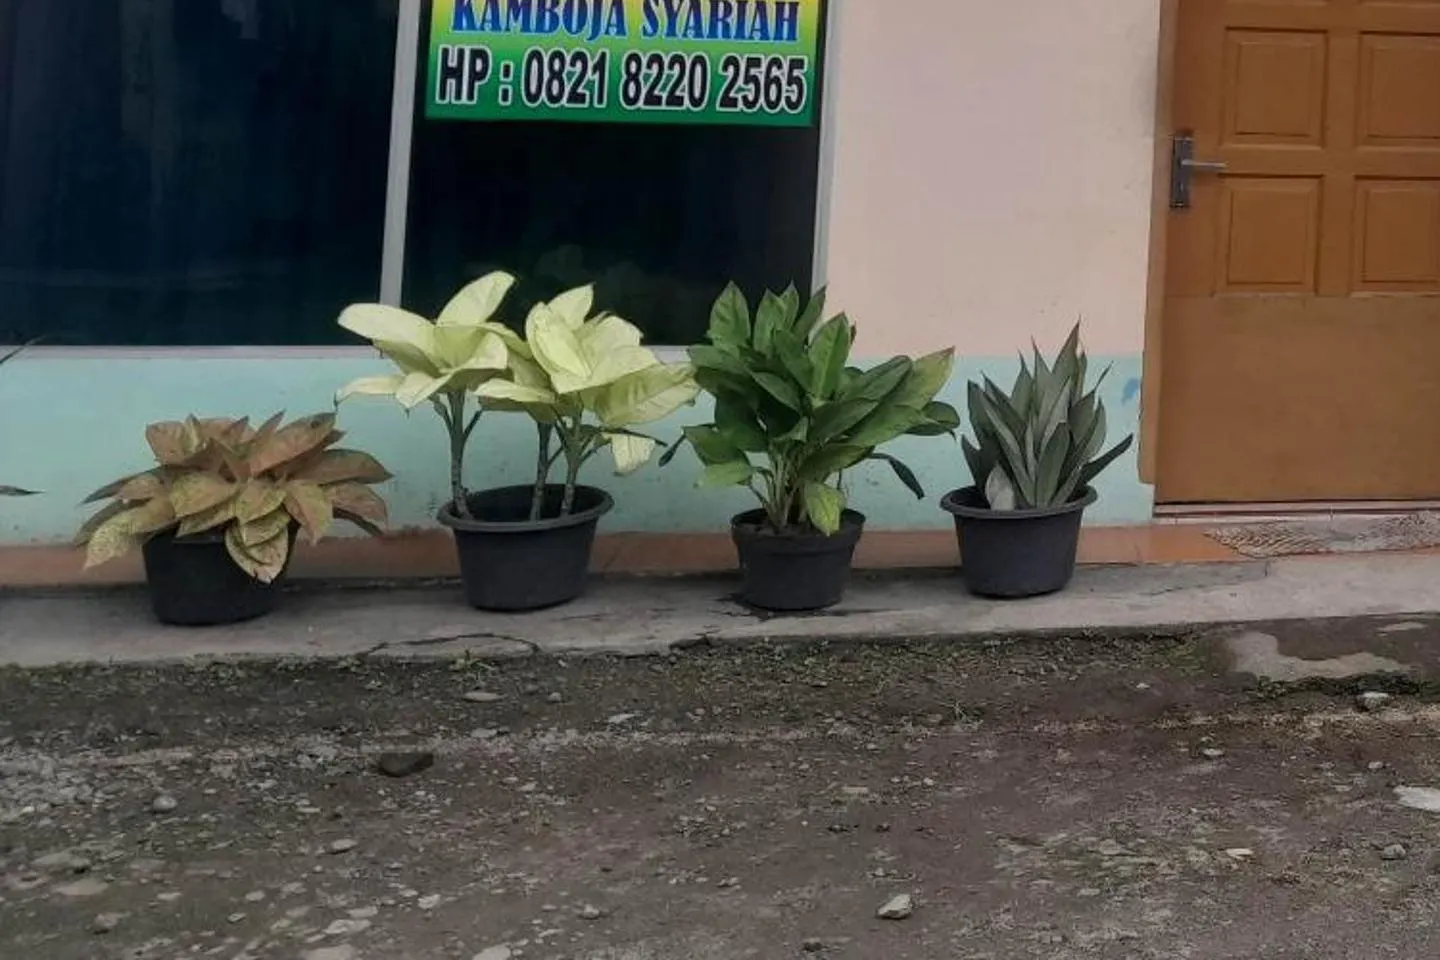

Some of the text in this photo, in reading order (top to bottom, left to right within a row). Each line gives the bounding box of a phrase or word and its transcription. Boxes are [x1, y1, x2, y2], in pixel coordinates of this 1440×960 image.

[437, 46, 491, 104] HP
[522, 48, 608, 107] 0821
[621, 51, 709, 109] 8220
[718, 55, 806, 112] 2565
